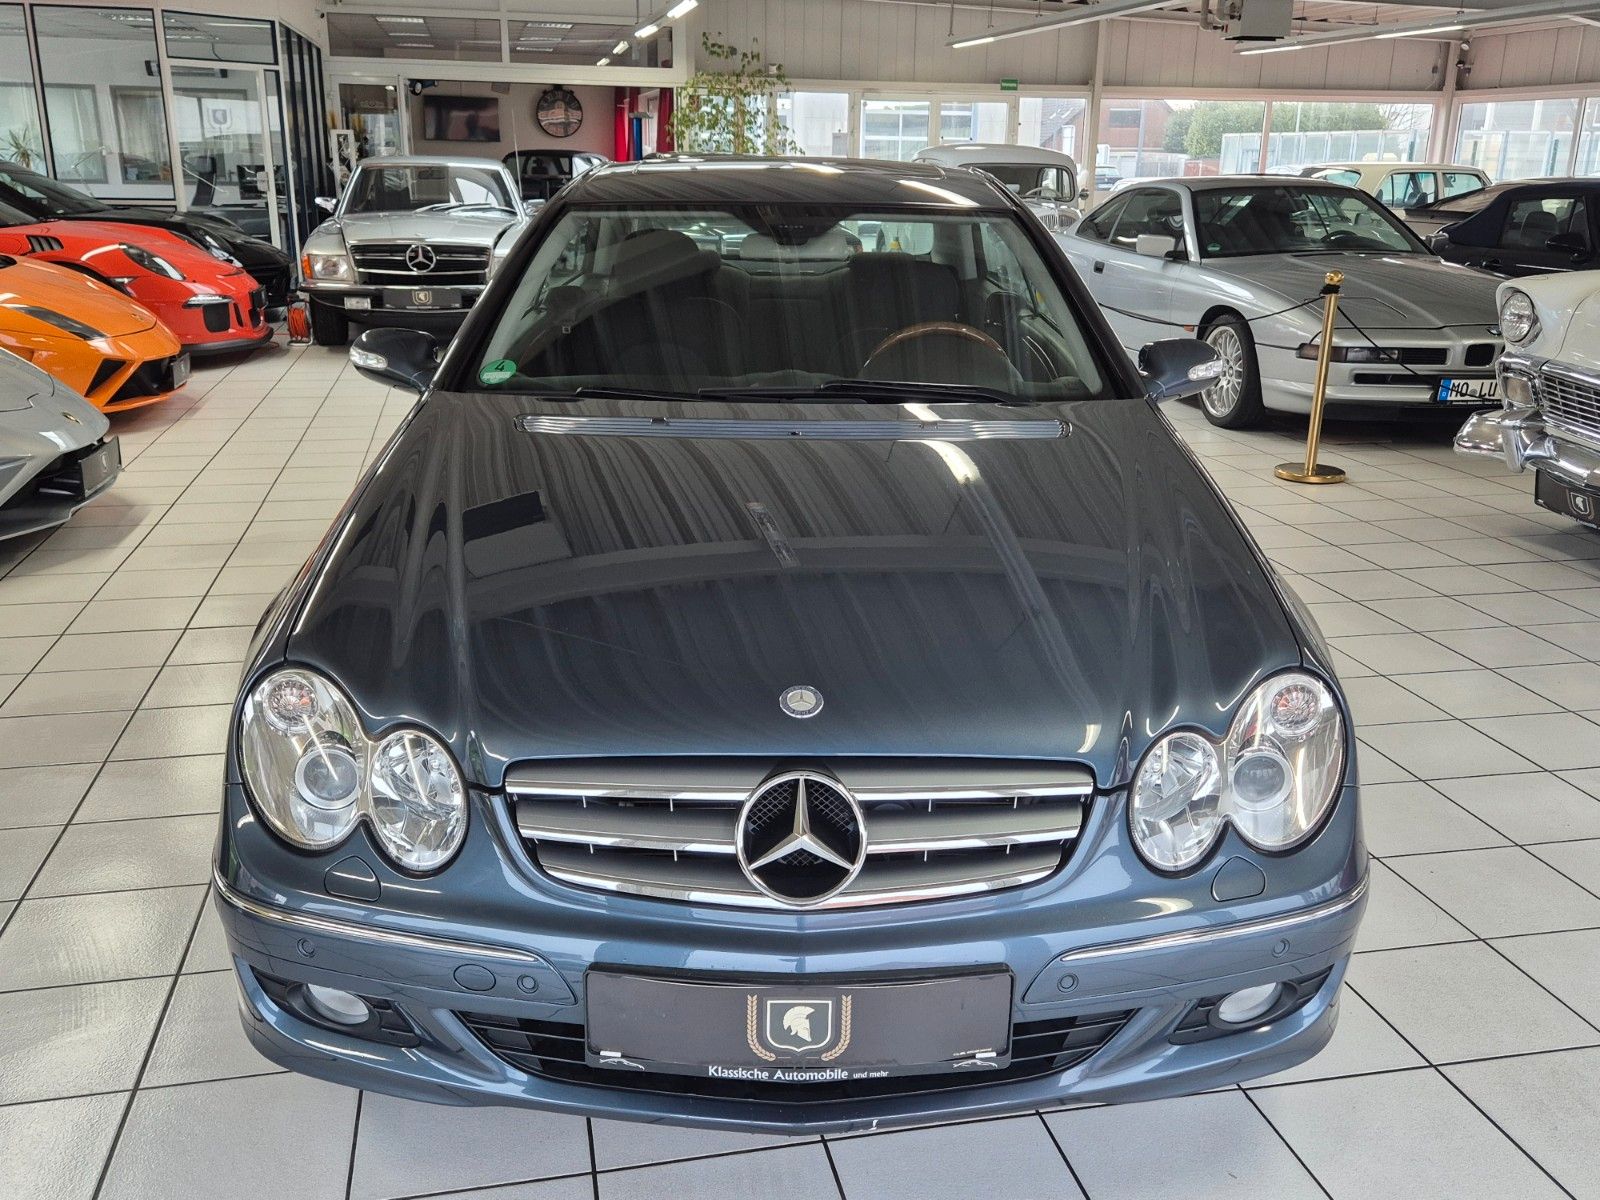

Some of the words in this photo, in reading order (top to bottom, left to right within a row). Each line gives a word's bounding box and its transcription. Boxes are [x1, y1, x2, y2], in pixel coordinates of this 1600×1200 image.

[495, 361, 505, 371] 4
[1449, 382, 1469, 398] MO
[708, 1065, 769, 1080] Klassische
[773, 1068, 849, 1081] Automobile
[853, 1071, 868, 1079] und
[869, 1070, 889, 1079] mehr
